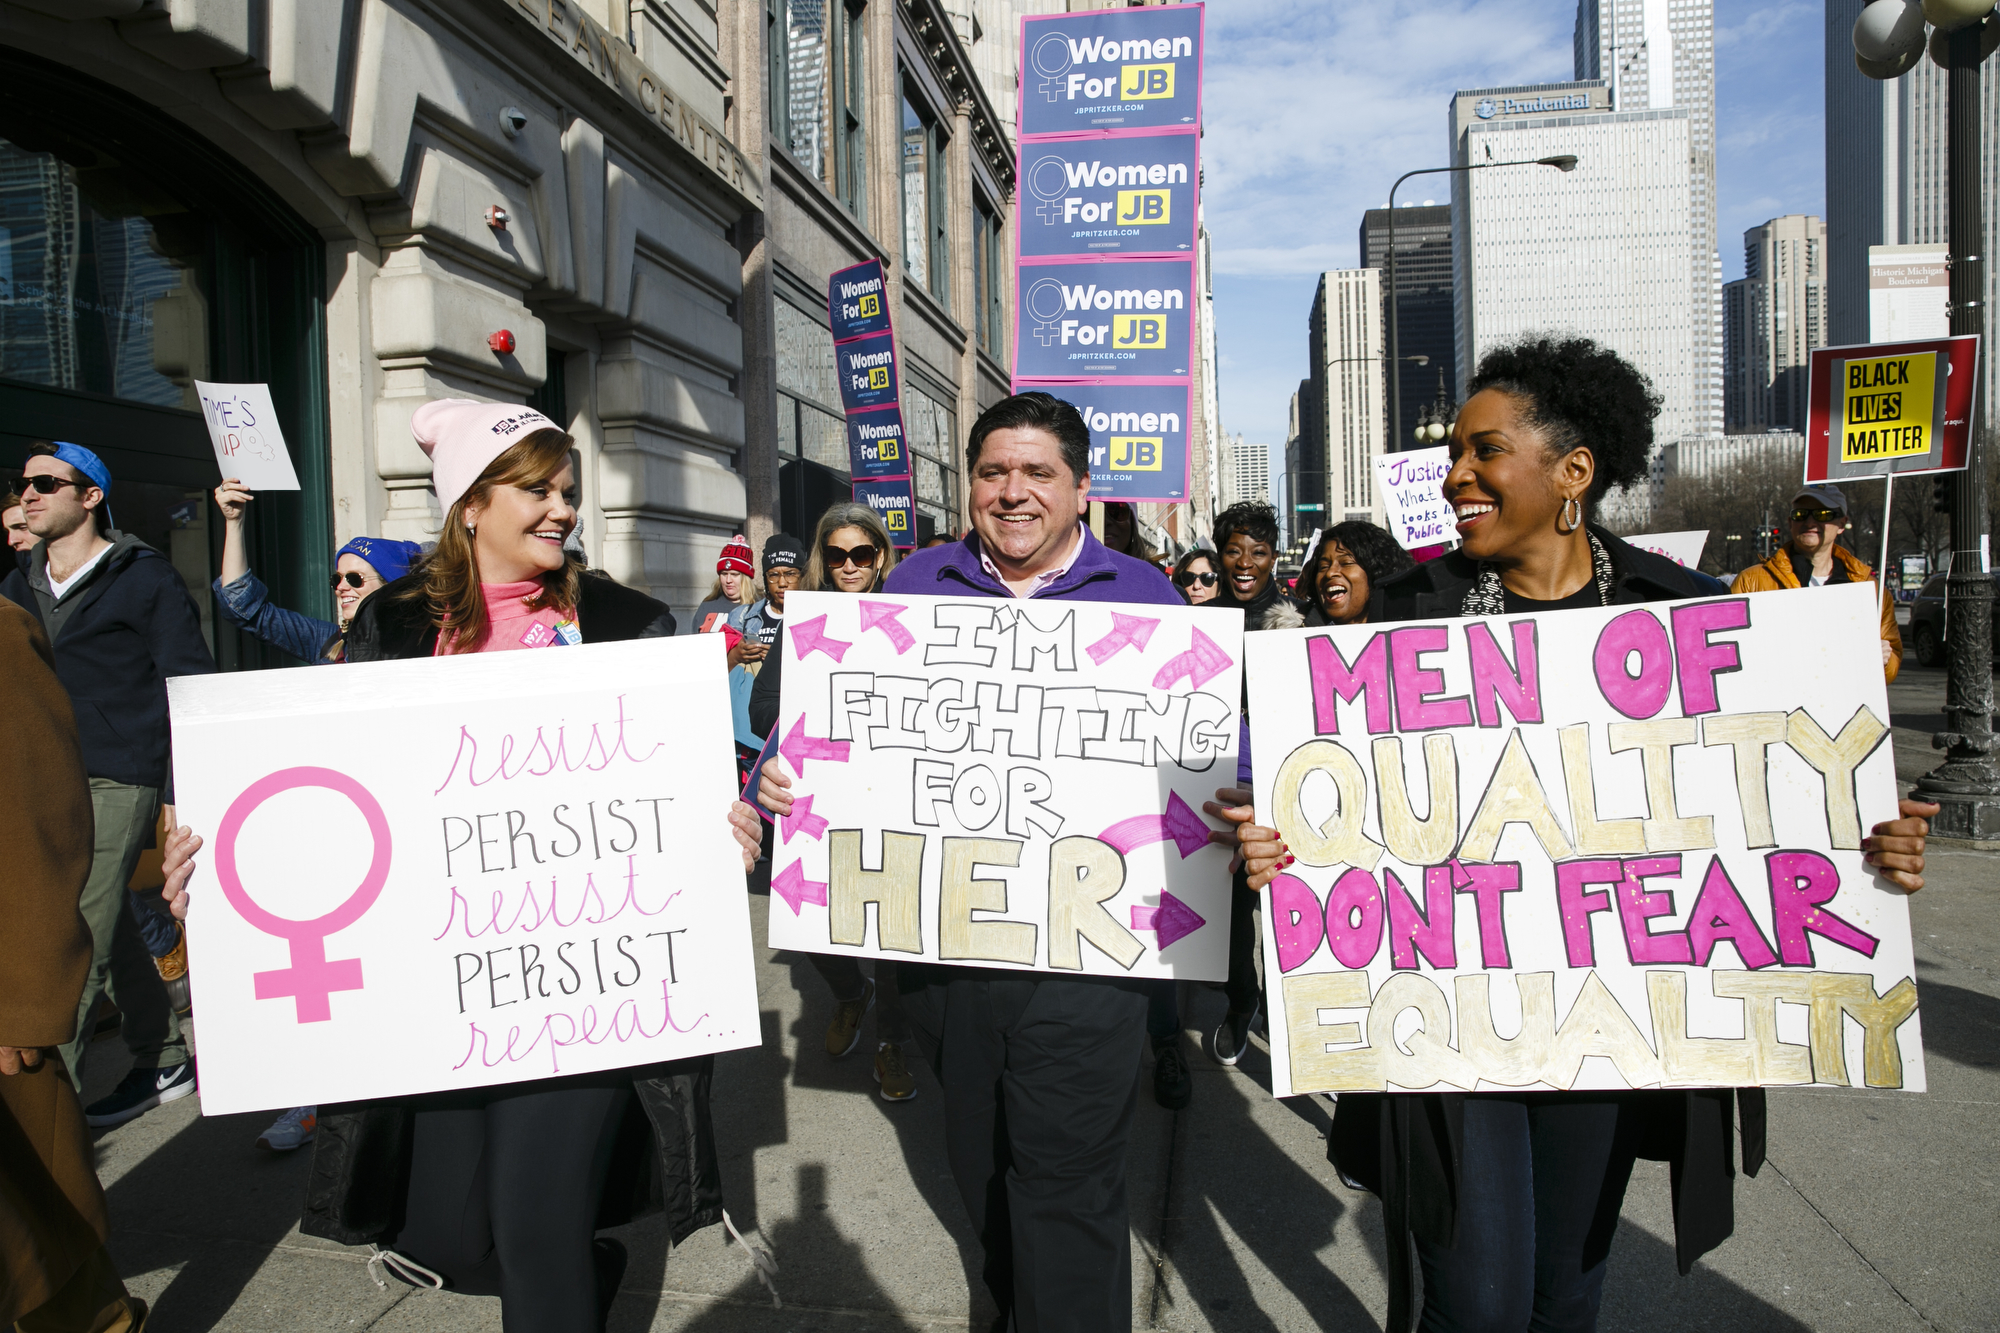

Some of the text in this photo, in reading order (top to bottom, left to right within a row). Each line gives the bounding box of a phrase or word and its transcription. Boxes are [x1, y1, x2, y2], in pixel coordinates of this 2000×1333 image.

[1068, 36, 1192, 65] Women
[1067, 69, 1168, 100] For JB
[1074, 104, 1144, 115] JBPRITZKER.COM
[1504, 92, 1590, 114] Prudential
[637, 72, 744, 192] CENTER
[1064, 160, 1188, 188] Women
[1064, 194, 1164, 224] For JB
[1071, 229, 1140, 238] JBPRITZKER.COM
[1872, 267, 1945, 276] Historic Michigan
[1888, 276, 1929, 286] Boulevard
[18, 283, 57, 300] School
[74, 298, 92, 310] the
[95, 303, 111, 316] Art
[19, 296, 31, 306] of
[841, 277, 882, 299] Women
[1061, 284, 1184, 311] Women
[842, 298, 877, 320] For JB
[1061, 320, 1160, 346] For JB
[850, 350, 892, 370] Women
[1068, 352, 1136, 360] JBPRITZKER.COM
[852, 370, 886, 390] For JB
[1850, 360, 1910, 389] BLACK
[203, 395, 256, 428] TIME'S
[1852, 394, 1900, 422] LIVES
[505, 424, 520, 435] FOR
[858, 424, 901, 440] Women
[1847, 426, 1922, 456] MATTER
[219, 434, 240, 457] UP
[861, 442, 896, 460] For JB
[1114, 442, 1156, 466] JB
[867, 494, 910, 508] Women
[1396, 486, 1437, 508] What
[891, 514, 904, 528] JB
[1402, 510, 1438, 525] Looks
[524, 624, 544, 644] 1973
[563, 628, 580, 642] JB
[924, 604, 1078, 672] I'M
[1305, 597, 1752, 736] MEN OF
[829, 672, 1232, 772] FIGHTING
[434, 694, 665, 796] resist
[913, 758, 1066, 839] FOR
[1272, 704, 1890, 872] QUALITY
[442, 798, 674, 877] PERSIST
[434, 854, 682, 940] resist
[828, 828, 1146, 971] HER
[1268, 849, 1880, 973] DON'T FEAR
[454, 928, 688, 1014] PERSIST
[1282, 969, 1918, 1094] EQUALITY
